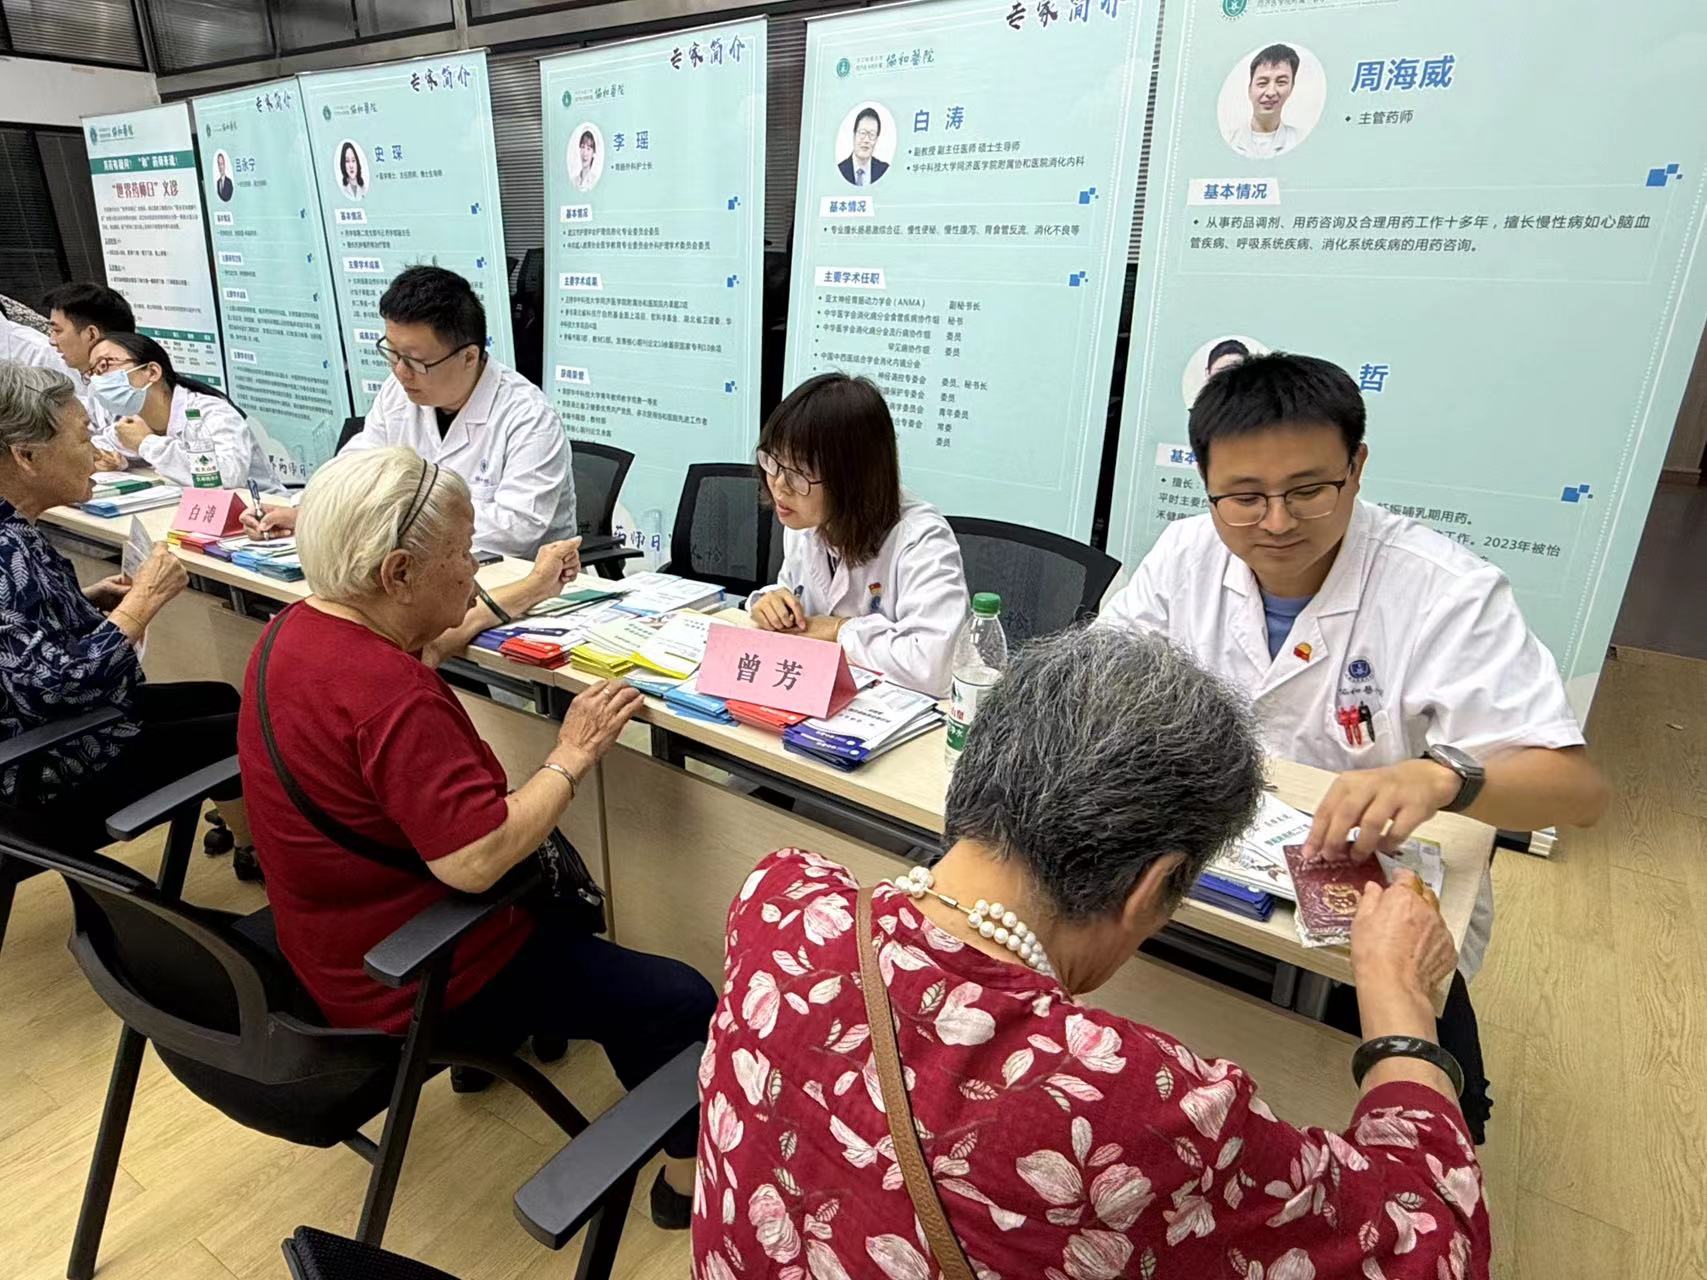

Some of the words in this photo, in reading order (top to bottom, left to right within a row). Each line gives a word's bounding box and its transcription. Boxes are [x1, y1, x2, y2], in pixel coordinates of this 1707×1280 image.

[670, 35, 746, 70] 专家简介
[410, 66, 471, 92] 专家简介
[1351, 55, 1455, 93] 周海威
[913, 106, 964, 134] 白涛
[1358, 109, 1414, 126] 主管药师
[613, 130, 649, 151] 李瑶
[1203, 184, 1268, 200] 基本情况
[829, 200, 867, 213] 基本情况
[1190, 237, 1479, 254] 管疾病、呼吸系统疾病、消化系统疾病的用药咨询。
[823, 271, 880, 285] 主要学术任职
[1359, 363, 1389, 392] 哲
[1433, 529, 1560, 557] 工作。2023年被怡
[736, 652, 804, 691] 曾芳
